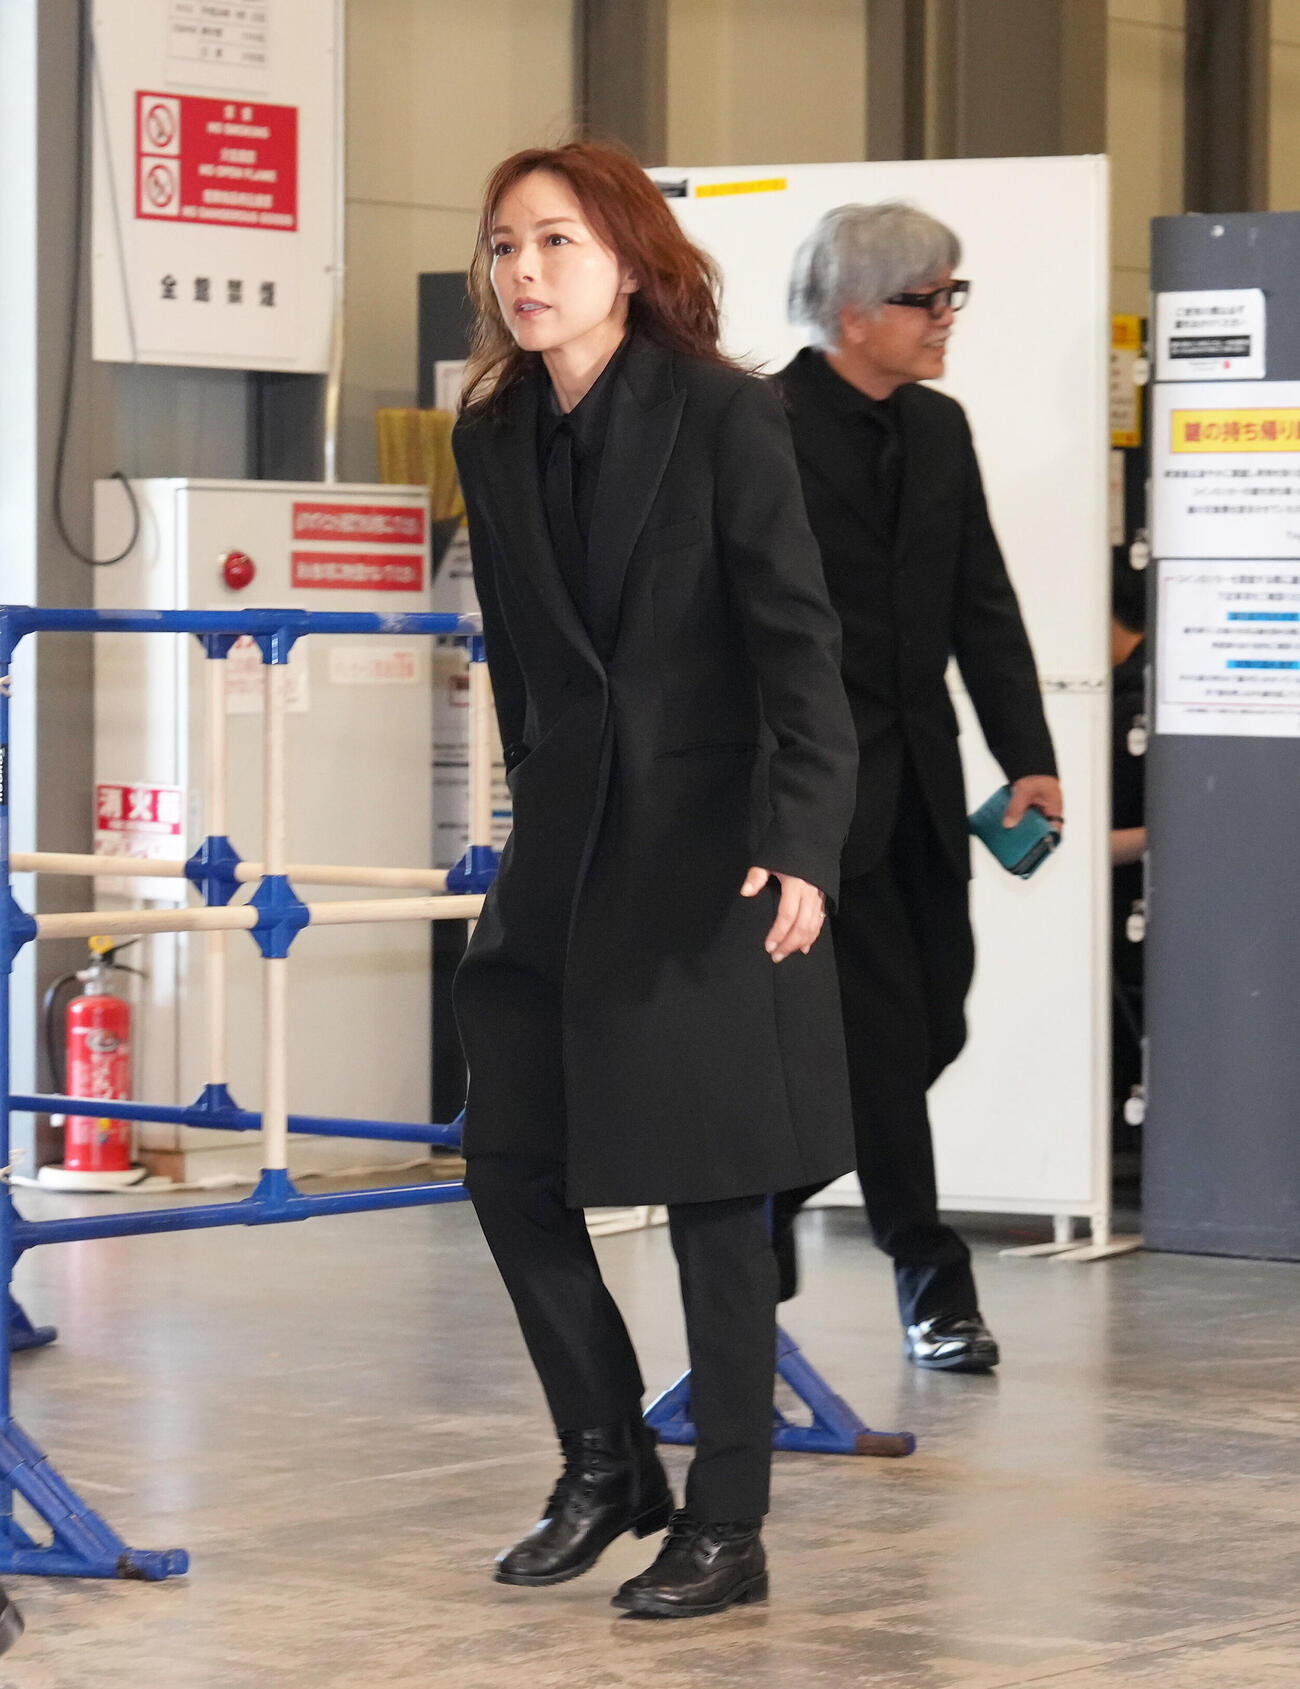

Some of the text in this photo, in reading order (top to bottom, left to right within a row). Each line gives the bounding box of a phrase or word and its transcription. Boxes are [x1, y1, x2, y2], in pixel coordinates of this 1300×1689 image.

[1184, 419, 1300, 442] 鍵の持ち帰り
